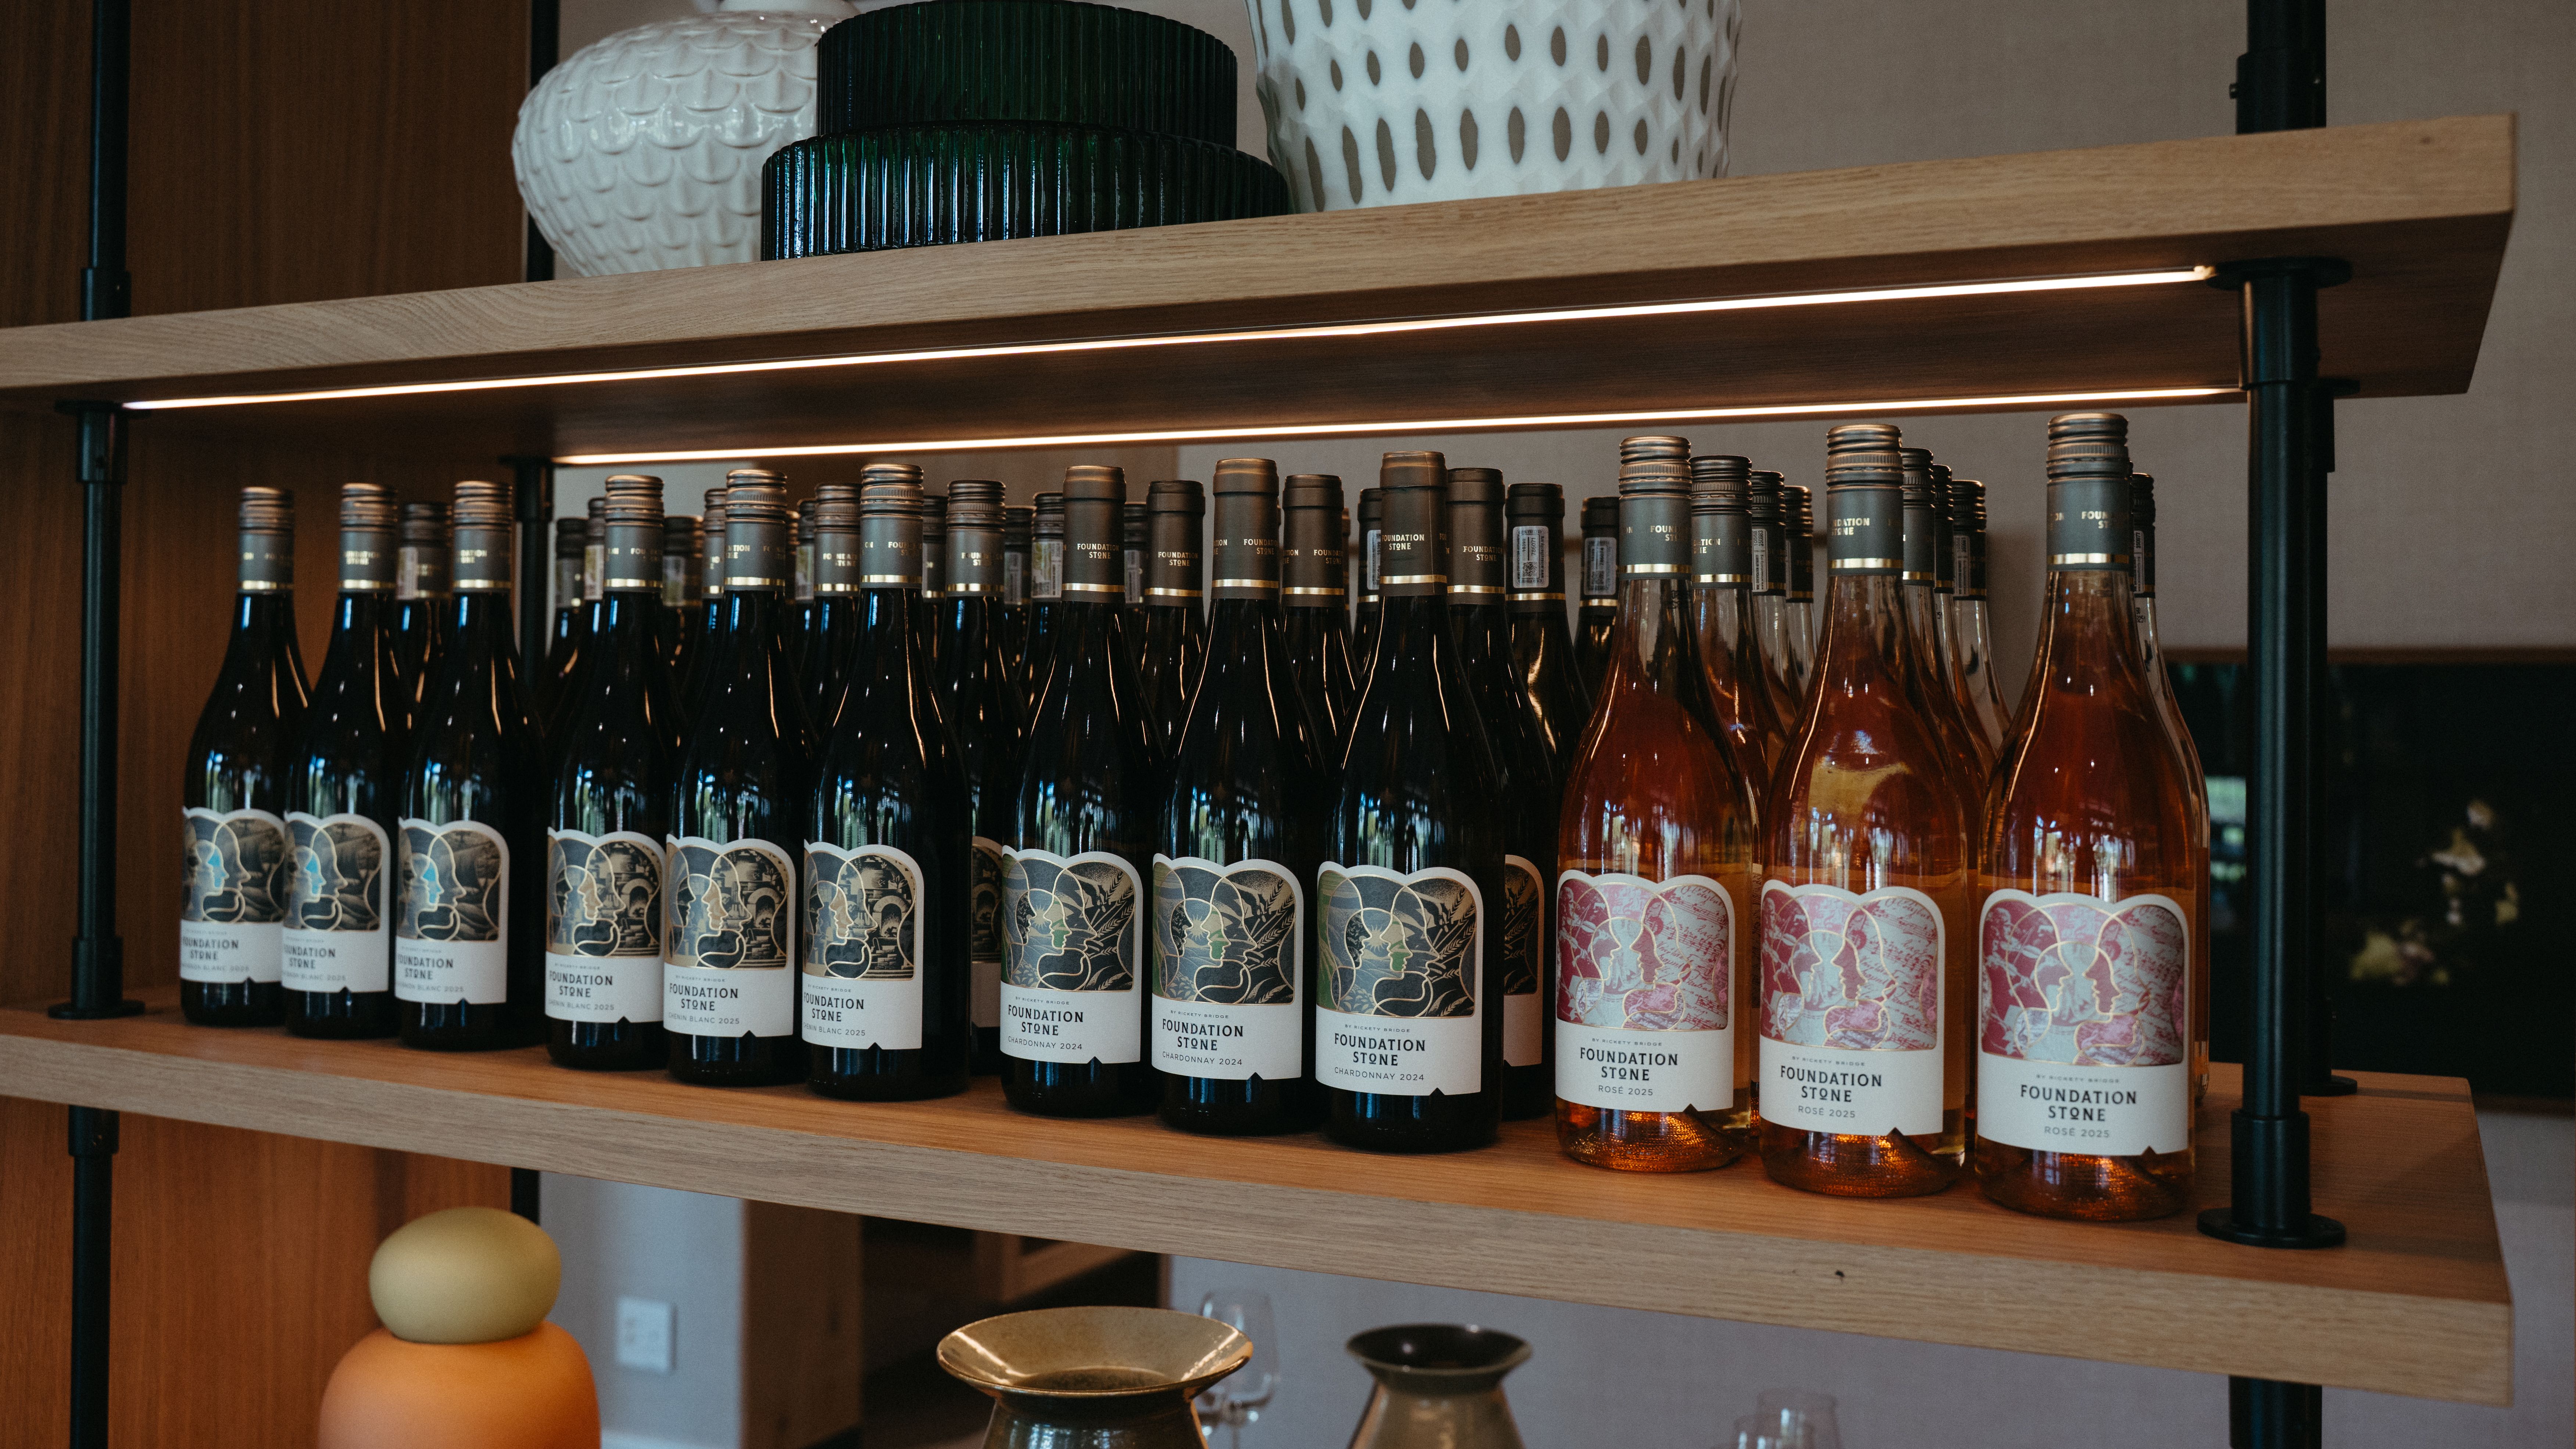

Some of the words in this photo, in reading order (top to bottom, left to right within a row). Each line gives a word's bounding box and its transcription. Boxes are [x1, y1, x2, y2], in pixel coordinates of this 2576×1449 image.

[1077, 543, 1119, 551] FOUNDATION
[289, 958, 315, 969] STONE
[405, 967, 433, 980] STONE
[550, 971, 613, 985] FOUNDATION
[560, 985, 591, 998] STONE
[670, 983, 738, 998] FOUNDATION
[681, 998, 715, 1011] STONE
[804, 992, 864, 1009] FOUNDATION
[669, 1012, 687, 1021] CHENIN
[812, 1008, 841, 1022] STONE
[1008, 1004, 1084, 1023] FOUNDATION
[819, 1026, 842, 1034] BLANC
[1022, 1022, 1059, 1036] STONE
[1162, 1018, 1244, 1037] FOUNDATION
[1008, 1036, 1056, 1049] CHARDONNAY
[1177, 1036, 1218, 1051] STONE
[1335, 1033, 1425, 1051] FOUNDATION
[1162, 1051, 1215, 1064] CHARDONNAY
[1353, 1051, 1398, 1066] STONE
[1580, 1047, 1678, 1066] FOUNDATION
[1335, 1067, 1395, 1080] CHARDONNAY
[1601, 1066, 1650, 1081] STONE
[1780, 1065, 1882, 1087] FOUNDATION
[1598, 1085, 1624, 1094] ROSÉ
[1628, 1088, 1654, 1096] 2025
[1801, 1085, 1852, 1102] STONE
[2021, 1084, 2137, 1105] FOUNDATION
[1798, 1105, 1824, 1116] ROSÉ
[1829, 1109, 1855, 1118] 2025
[2048, 1105, 2106, 1122] STONE
[2044, 1126, 2076, 1137] ROSÉ
[2081, 1129, 2110, 1138] 2025
